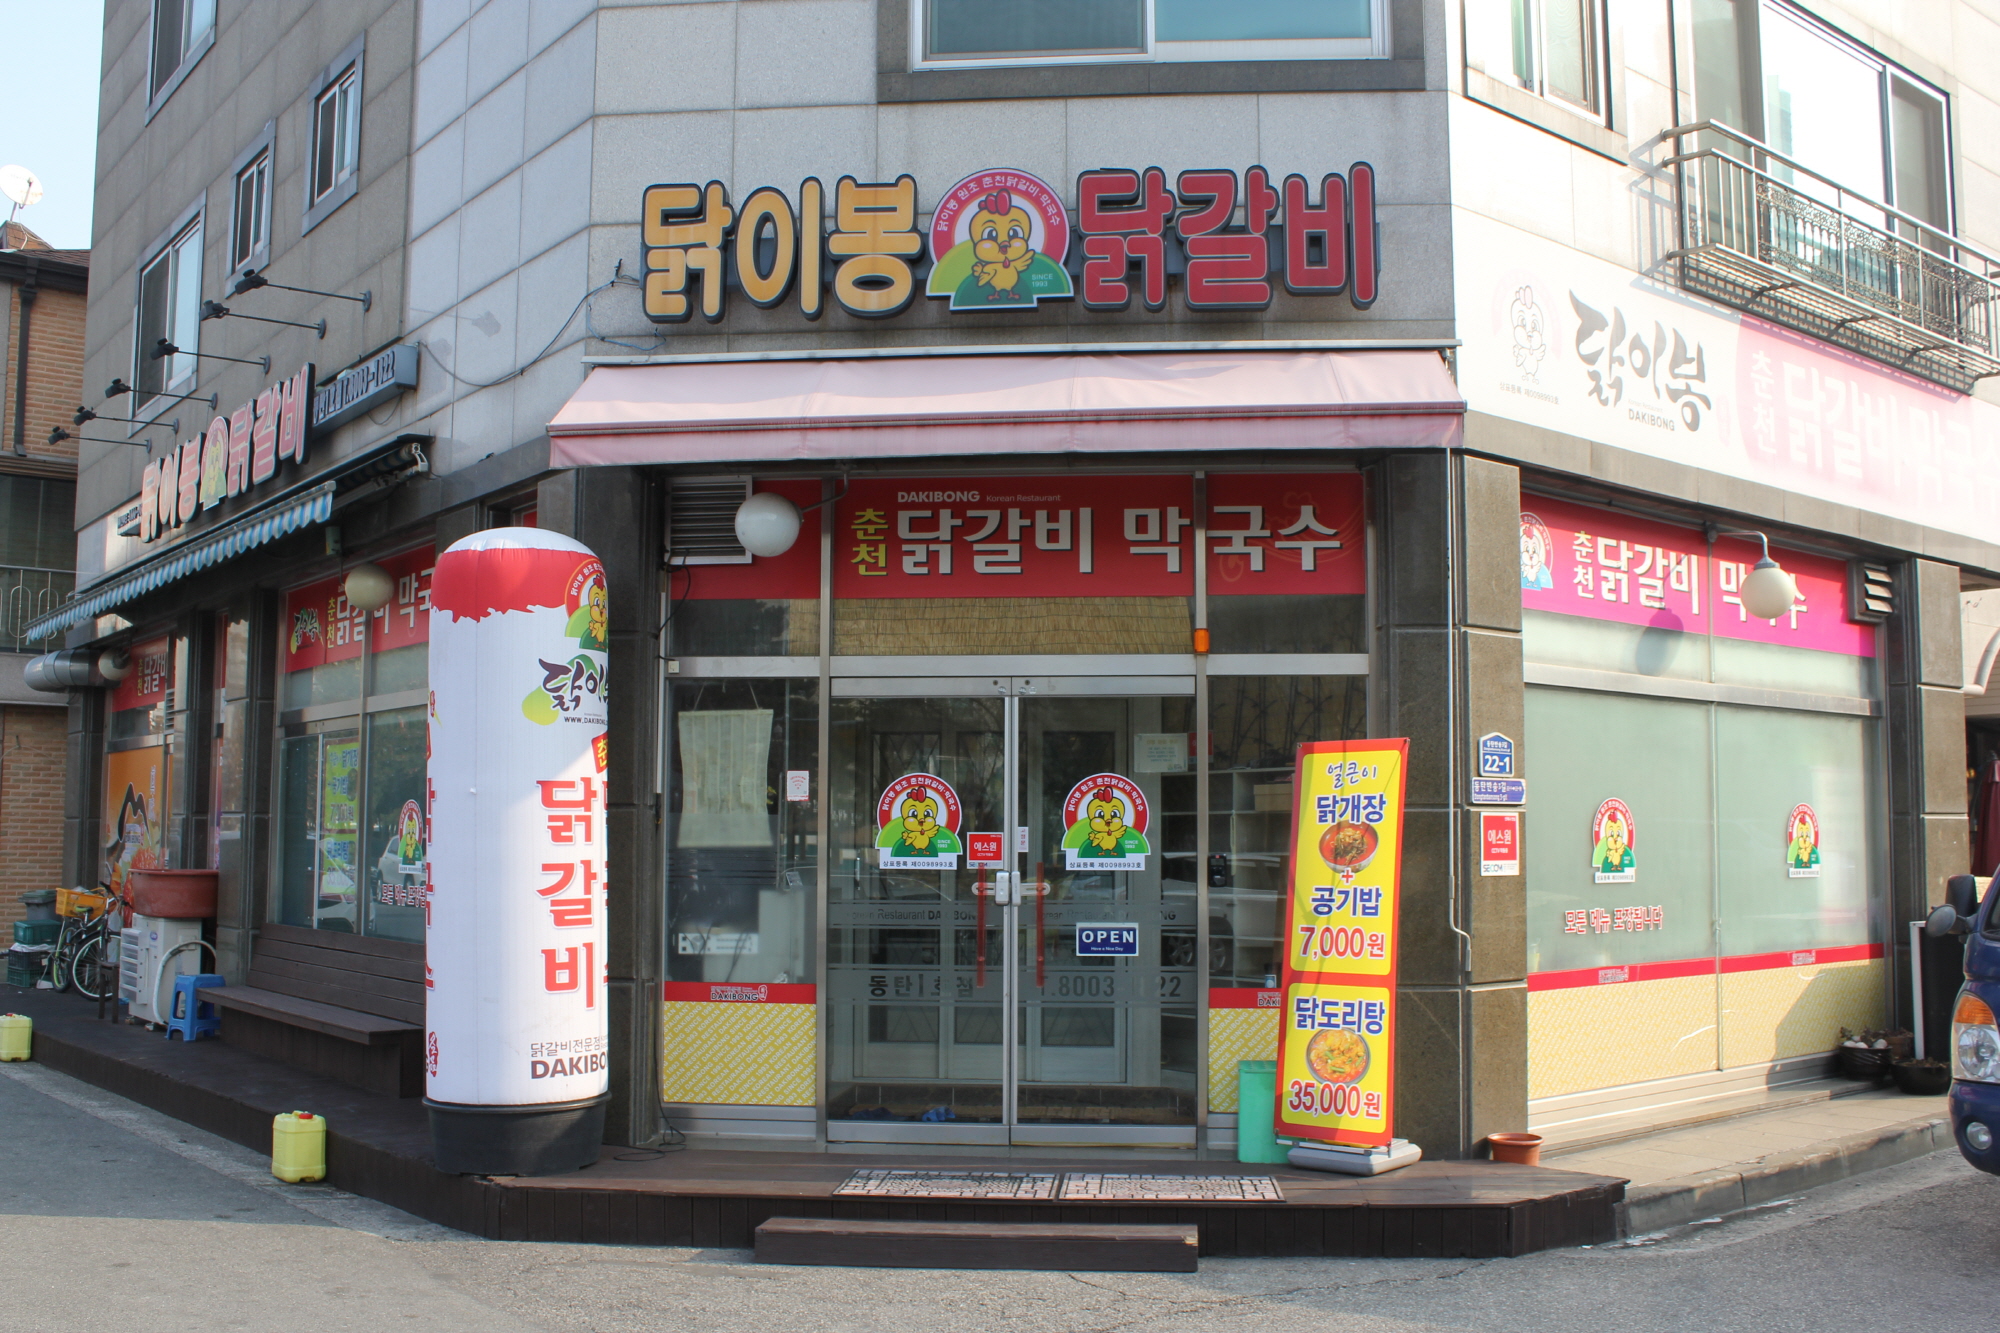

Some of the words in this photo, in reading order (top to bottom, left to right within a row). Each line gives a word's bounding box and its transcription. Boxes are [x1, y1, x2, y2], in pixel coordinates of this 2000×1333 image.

[937, 198, 959, 232] 닭이봉
[957, 181, 980, 201] 원조
[641, 174, 925, 322] 닭이봉
[1077, 162, 1376, 311] 닭갈비
[1568, 289, 1712, 432] 닭이봉
[1628, 408, 1676, 431] DAKIBONG
[1781, 361, 1901, 487] 닭갈비
[140, 432, 206, 544] 닭이봉
[228, 362, 314, 499] 닭갈비
[897, 491, 981, 503] DAKIBONG
[986, 494, 1015, 502] Korean
[1016, 493, 1062, 502] Restaurant
[850, 508, 889, 576] 춘천
[896, 508, 1095, 576] 닭갈비
[1123, 505, 1343, 573] 막국수
[1573, 531, 1594, 599] 춘천
[1597, 537, 1700, 614] 닭갈비
[1484, 755, 1510, 772] 22-1
[1315, 793, 1387, 824] 닭개장
[973, 841, 997, 851] 에스원
[1487, 829, 1512, 845] 에스원
[535, 776, 598, 1010] 닭갈비
[1310, 886, 1382, 917] 공기밥
[877, 908, 926, 921] Restaurant
[1564, 908, 1587, 935] 모든
[1589, 907, 1611, 934] 메뉴
[1613, 905, 1663, 933] 포장됩니다
[1081, 930, 1134, 943] OPEN
[1299, 926, 1386, 960] 7,000원
[711, 993, 759, 1001] DAKIBONG
[1294, 997, 1386, 1035] 닭도리탕
[1288, 1079, 1381, 1118] 35,000원
